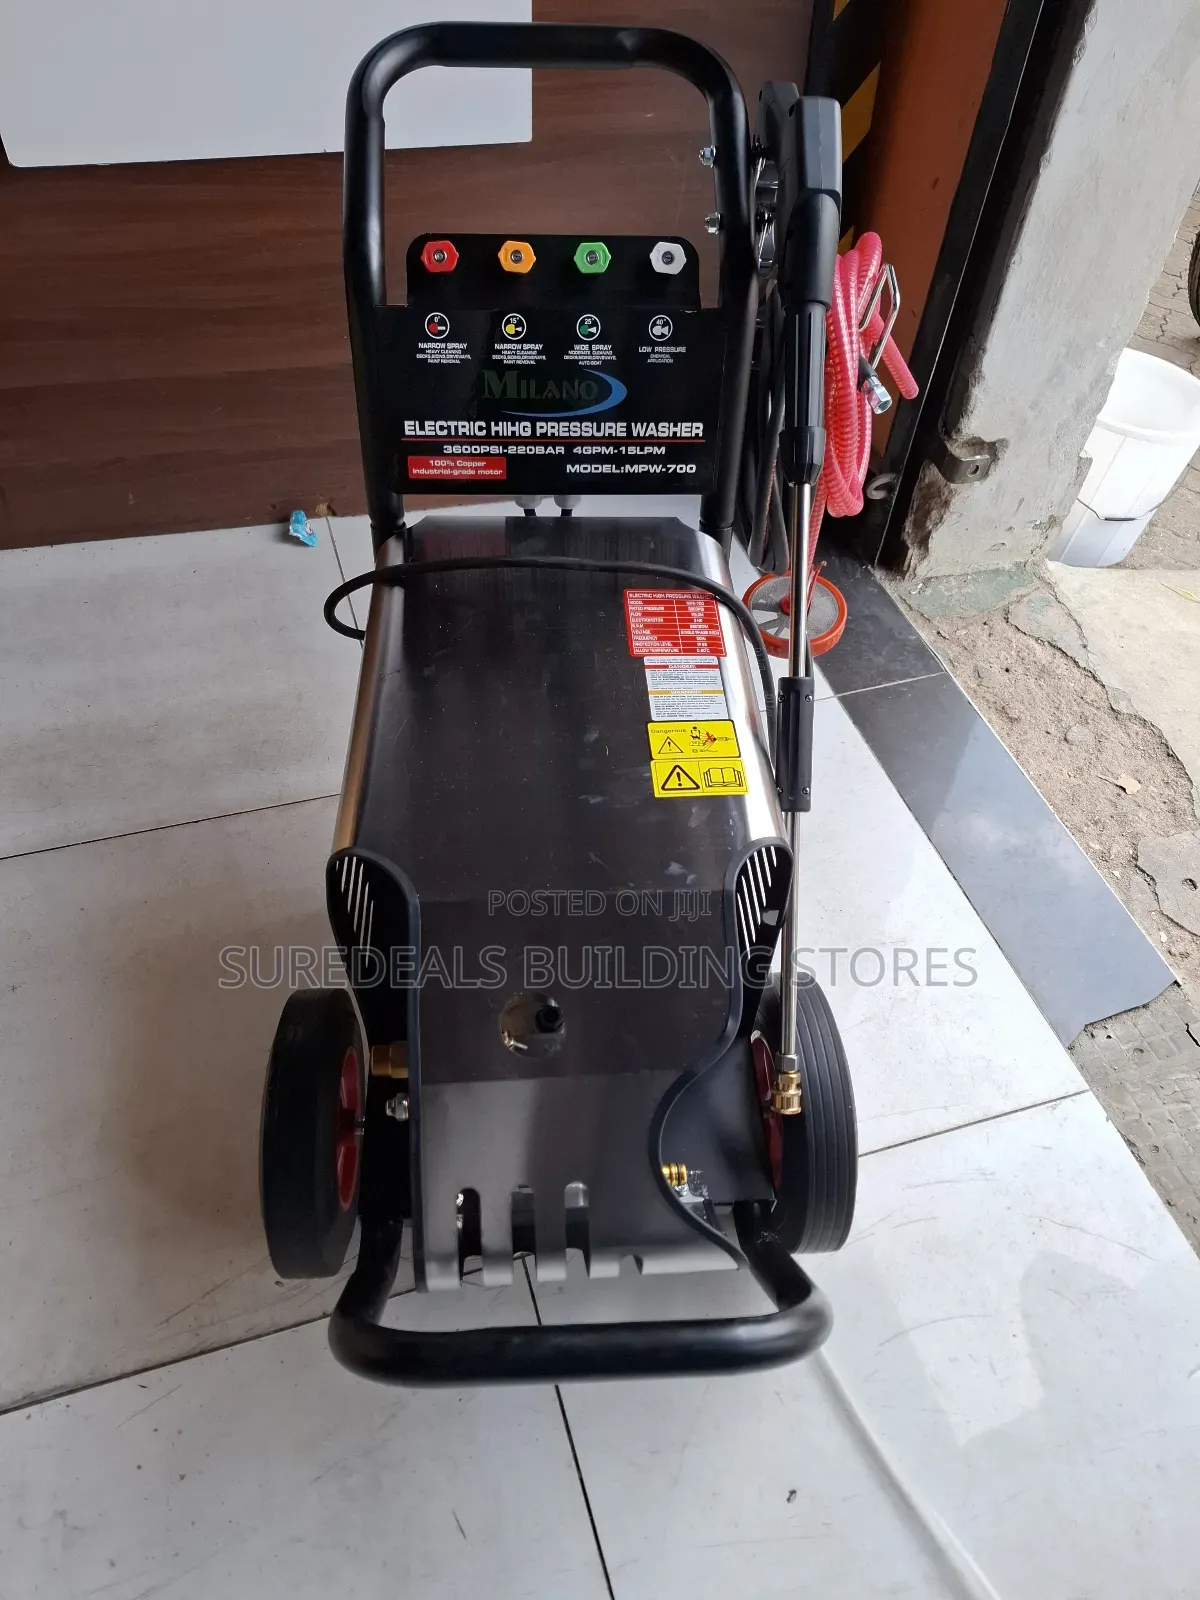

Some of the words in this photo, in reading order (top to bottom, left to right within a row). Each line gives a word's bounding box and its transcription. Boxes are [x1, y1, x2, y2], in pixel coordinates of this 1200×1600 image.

[404, 420, 487, 436] ELECTRIC
[490, 421, 532, 437] HIHG
[536, 421, 627, 437] PRESSURE
[631, 422, 704, 437] WASHER
[443, 445, 565, 455] 3600PSI-220BAR
[572, 446, 666, 455] 4GPM-15LPM
[456, 460, 487, 468] Copper
[566, 464, 697, 474] MODEL:MPW-700
[412, 468, 476, 476] Industrial-grade
